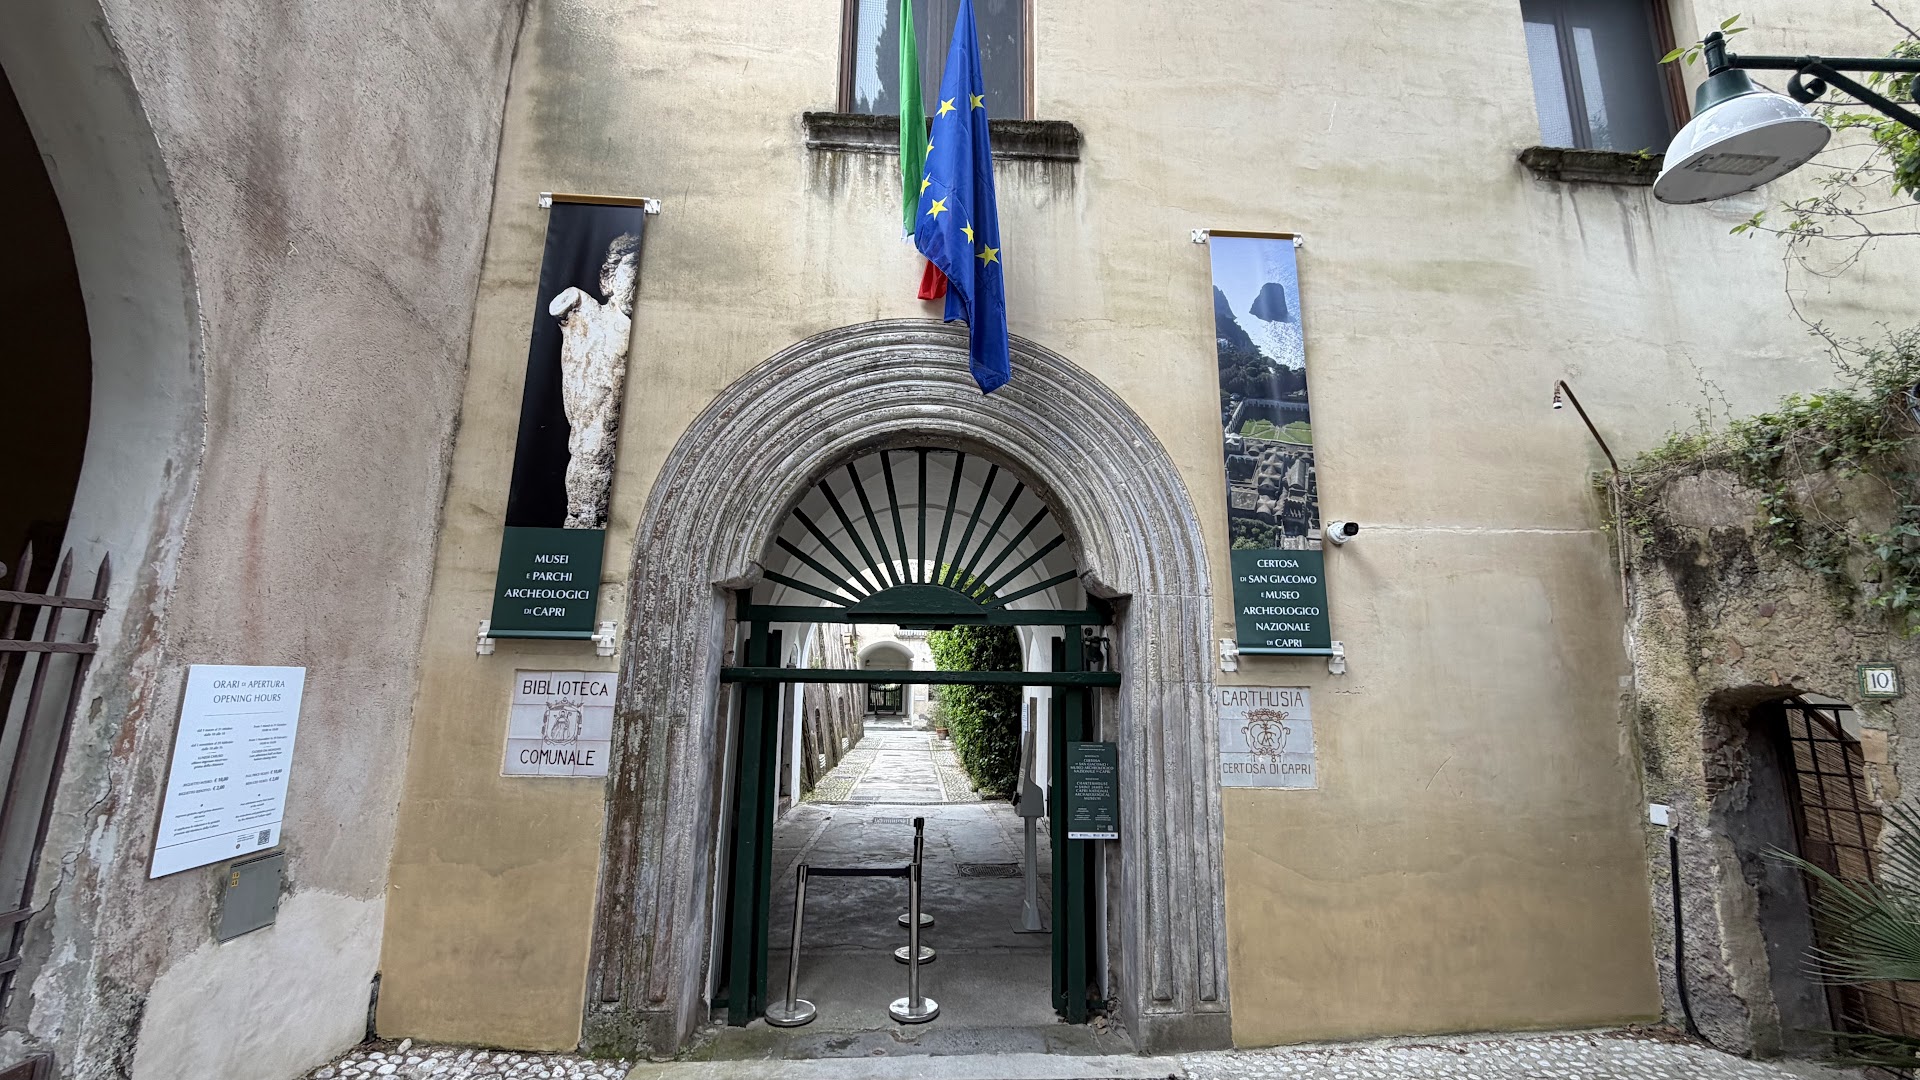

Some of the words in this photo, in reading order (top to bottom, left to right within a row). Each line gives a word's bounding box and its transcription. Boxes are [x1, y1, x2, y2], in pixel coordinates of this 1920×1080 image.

[534, 554, 569, 564] MUSEI
[1257, 559, 1299, 568] CERTOSA
[532, 571, 573, 582] PARCHI
[1248, 575, 1268, 584] SAN
[1270, 575, 1317, 584] GIACOMO
[504, 588, 590, 600] ARCHEOLOGICI
[1266, 591, 1300, 600] MUSEO
[532, 606, 566, 617] CAPRI
[1243, 606, 1320, 616] ARCHEOLOGICO
[1256, 622, 1310, 632] NAZIONALE
[1275, 638, 1302, 648] CAPRI
[213, 680, 240, 688] ORARI
[248, 679, 285, 688] APERTURA
[1872, 672, 1888, 688] 10
[522, 680, 609, 697] BIBLIOTECA
[213, 694, 252, 704] OPENING
[254, 694, 281, 702] HOURS
[1222, 690, 1304, 708] CARTHUSIA
[520, 749, 596, 766] COMUNALE
[1222, 762, 1266, 774] CERTOSA
[1270, 763, 1279, 774] DI
[1282, 763, 1311, 774] CAPRI
